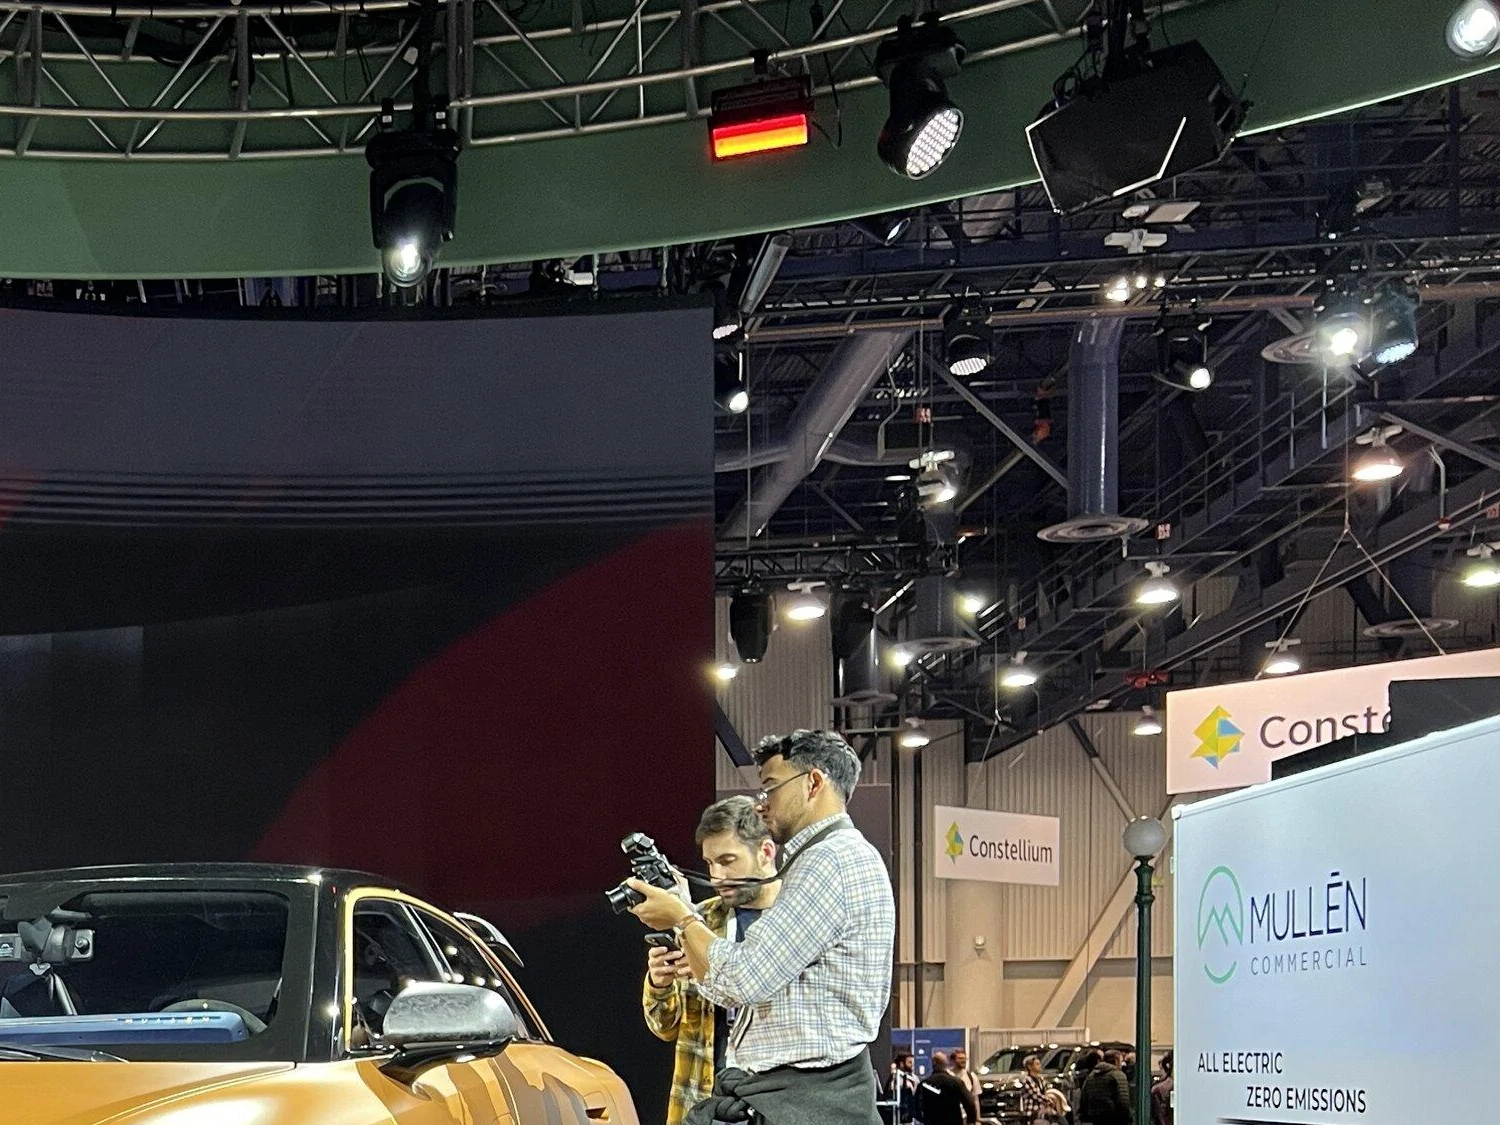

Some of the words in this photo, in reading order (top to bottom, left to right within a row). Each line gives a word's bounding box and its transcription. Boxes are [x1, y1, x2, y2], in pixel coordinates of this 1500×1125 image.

[969, 834, 1053, 864] Constellium
[1250, 870, 1367, 944] MULLĒN
[1250, 946, 1367, 976] COMMERCIAL
[1197, 1052, 1220, 1074] ALL
[1222, 1052, 1284, 1075] ELECTRIC
[1246, 1086, 1282, 1110] ZERO
[1286, 1087, 1367, 1114] EMISSIONS
